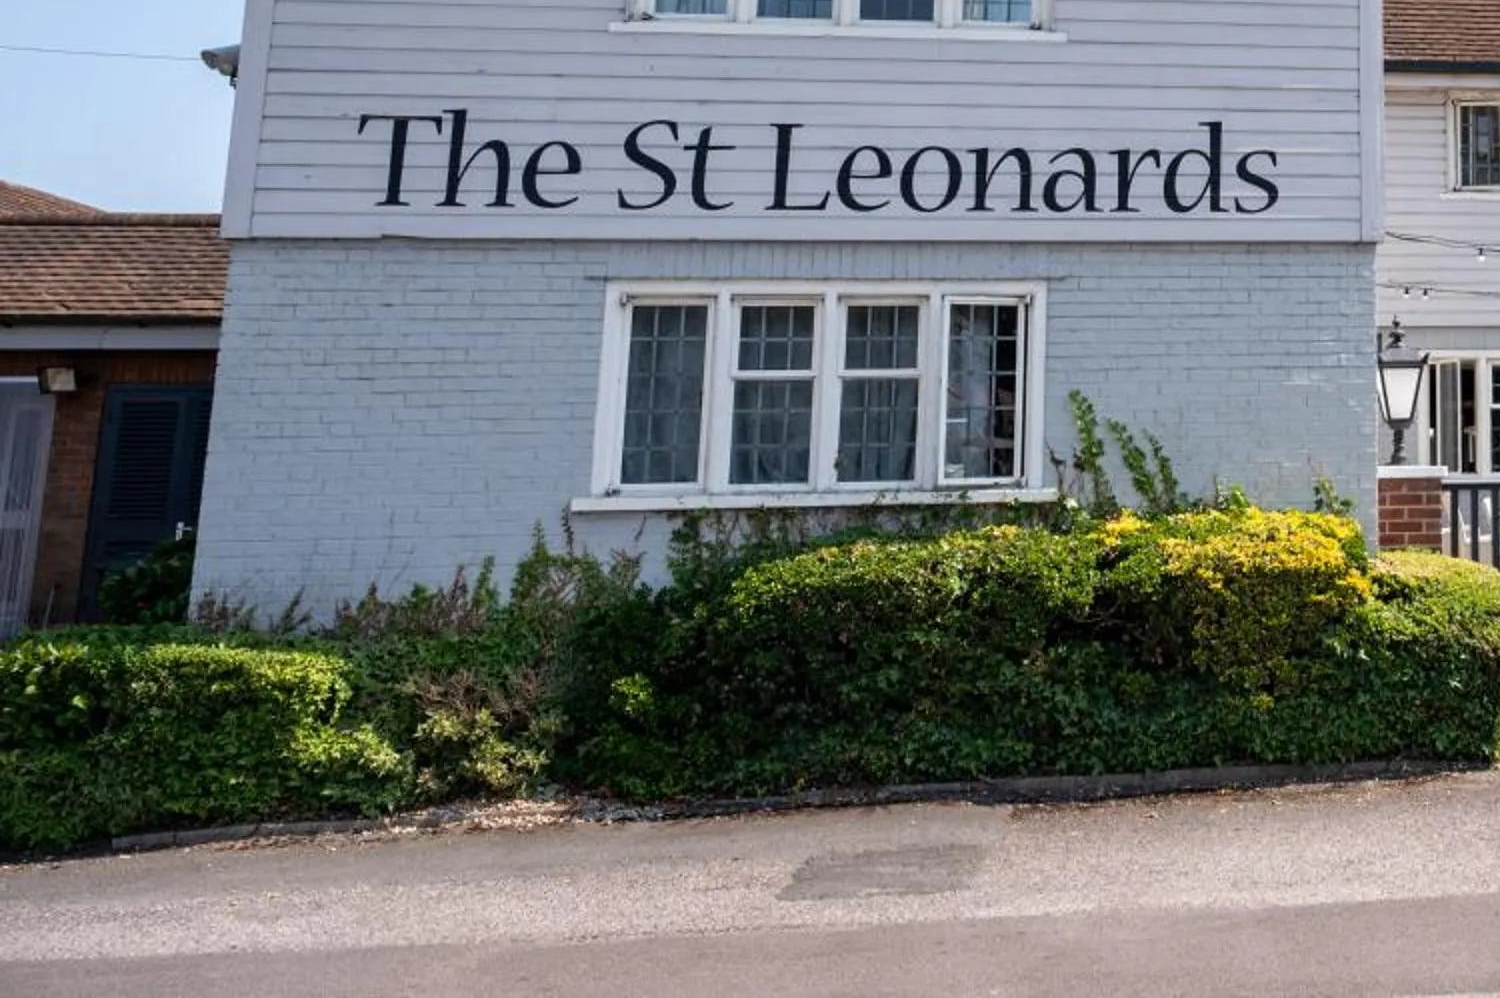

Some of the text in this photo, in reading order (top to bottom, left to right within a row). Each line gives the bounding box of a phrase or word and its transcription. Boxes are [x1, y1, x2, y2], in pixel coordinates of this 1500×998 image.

[358, 109, 1280, 214] The St Leonards
